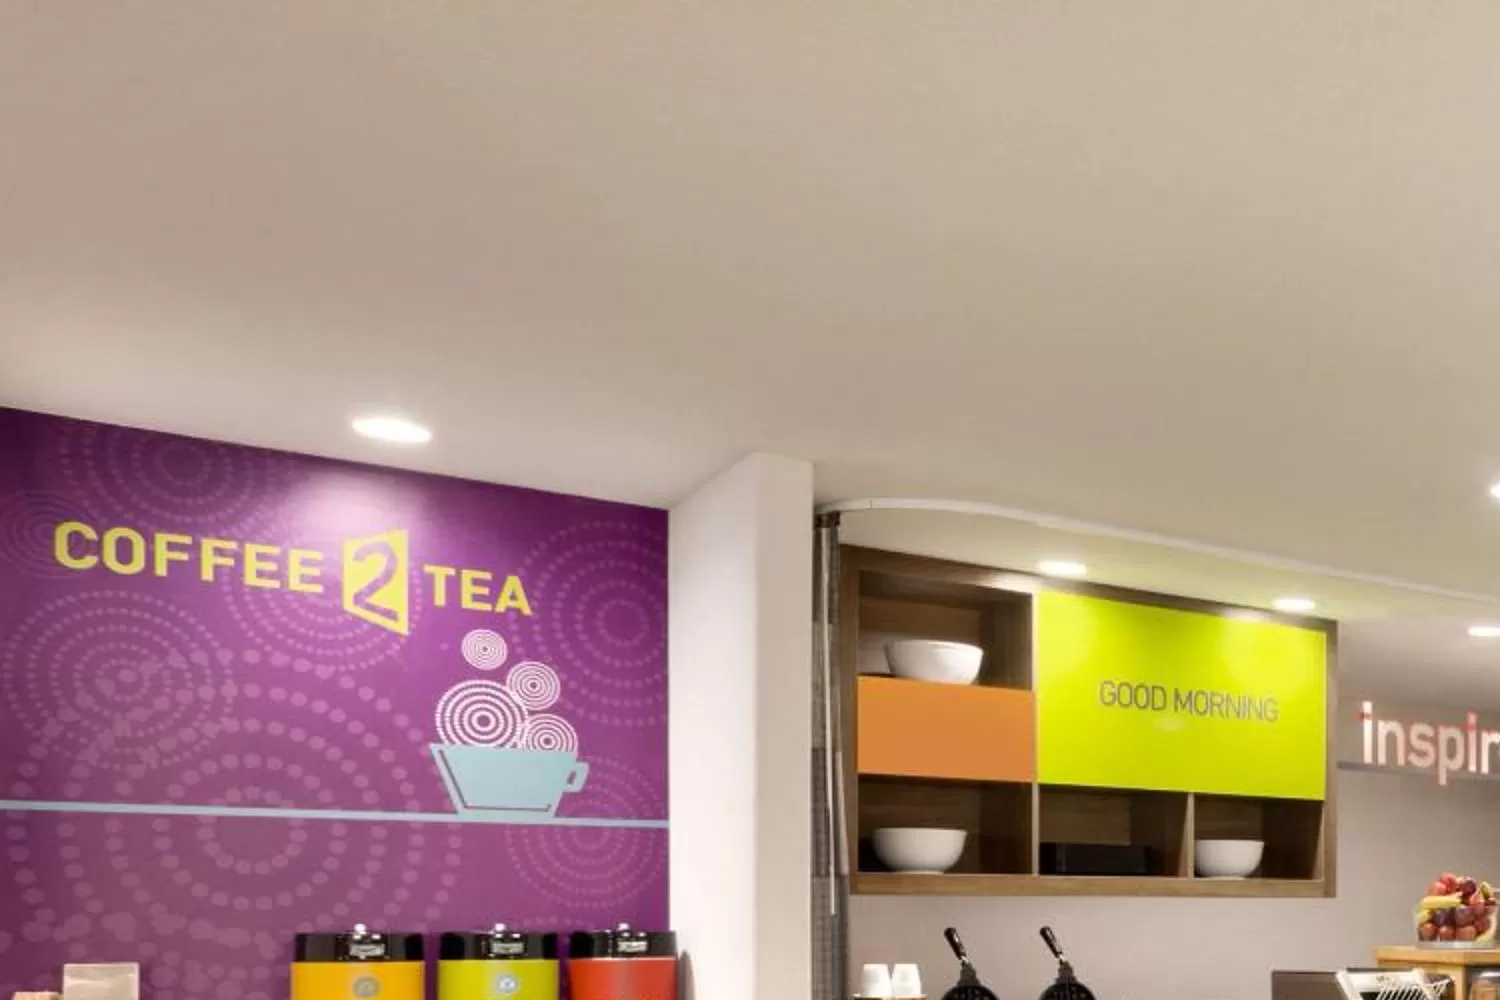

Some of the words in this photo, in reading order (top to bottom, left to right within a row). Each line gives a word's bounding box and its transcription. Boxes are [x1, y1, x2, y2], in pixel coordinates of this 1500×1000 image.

[54, 521, 324, 593] COFFEE
[347, 540, 403, 625] 2
[424, 564, 533, 616] TEA
[1099, 680, 1167, 711] GOOD
[1174, 688, 1279, 722] MORNING
